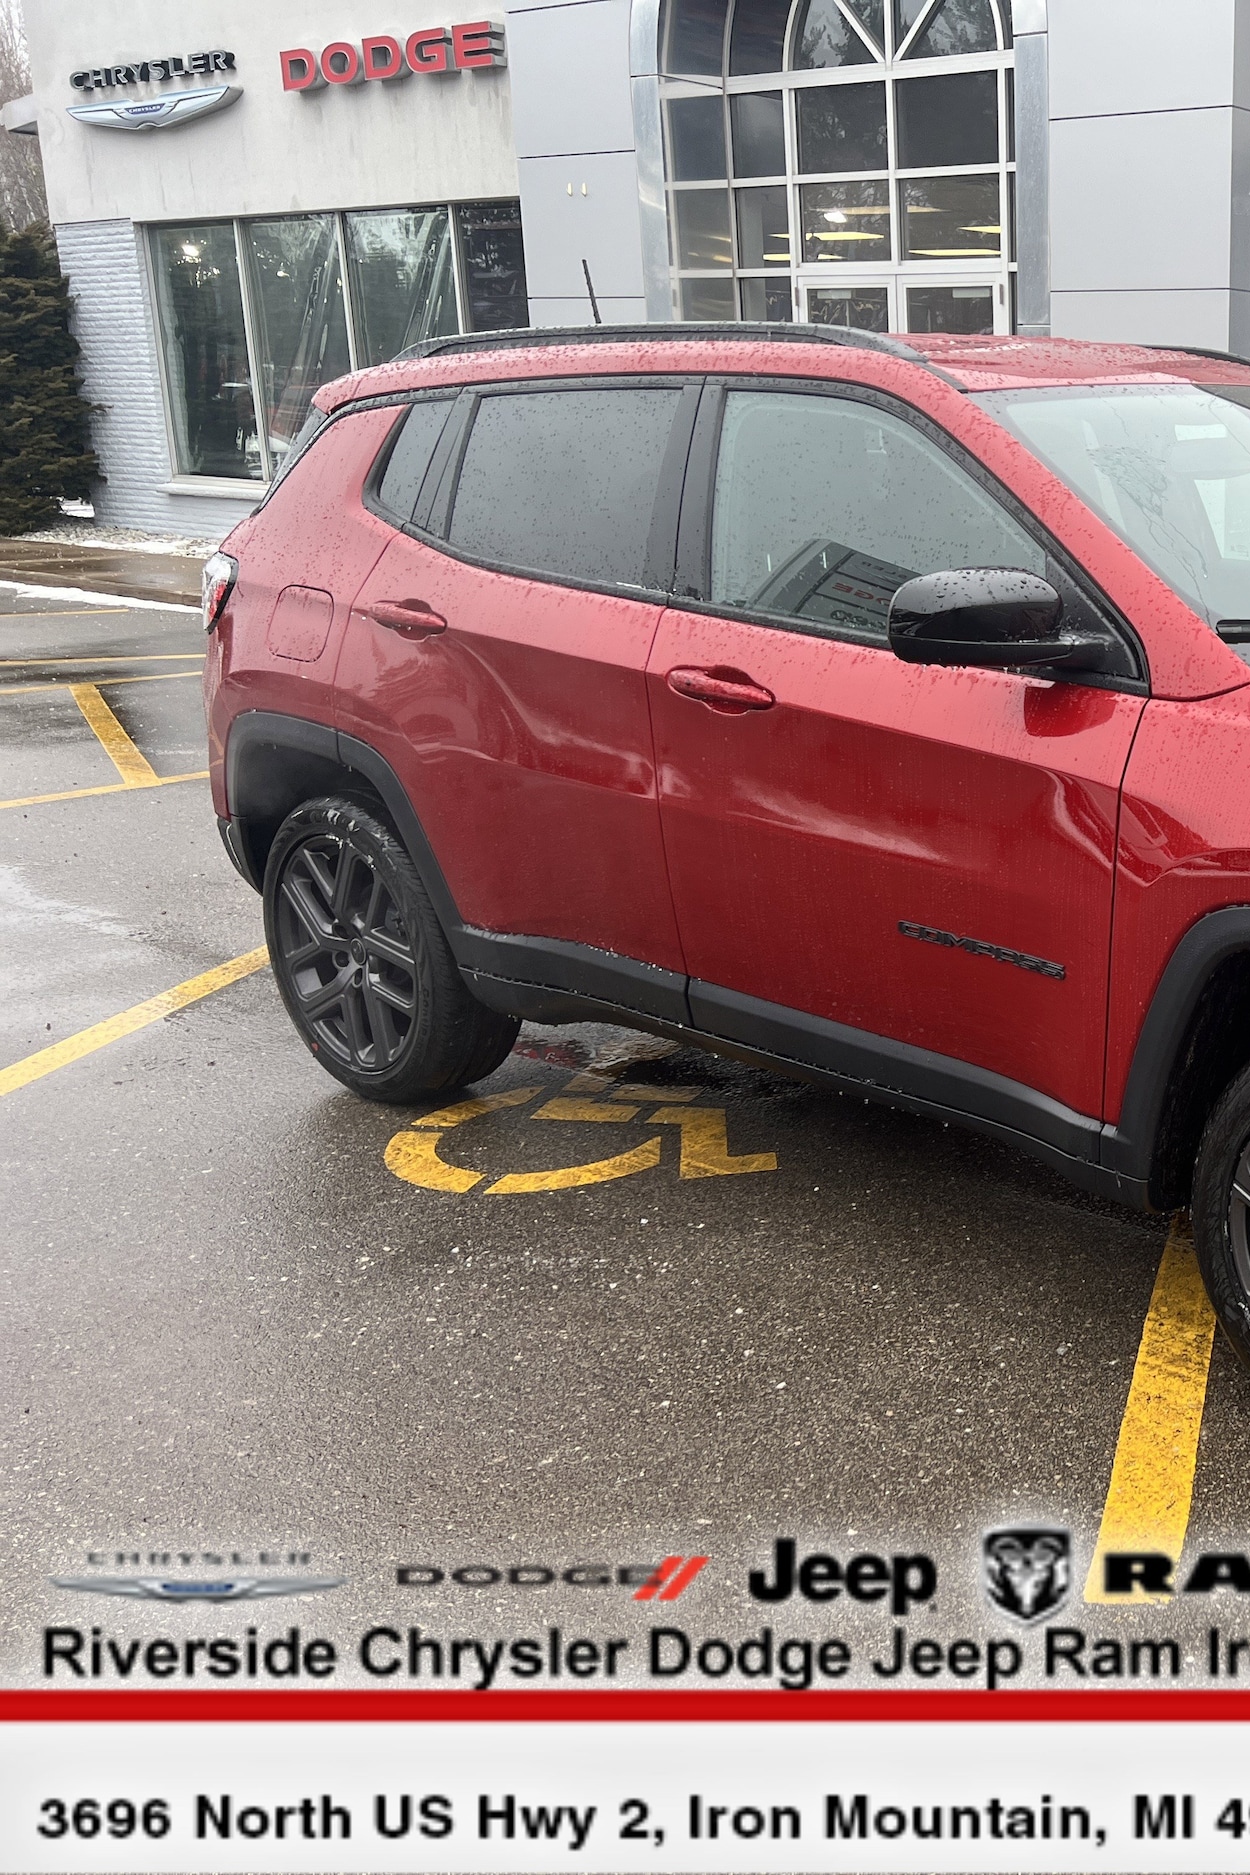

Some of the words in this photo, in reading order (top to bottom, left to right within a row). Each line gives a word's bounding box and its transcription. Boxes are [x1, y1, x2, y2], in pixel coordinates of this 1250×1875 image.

[69, 50, 236, 92] CHRYSLER
[279, 20, 506, 92] DODGE
[897, 919, 1065, 981] COMPASS
